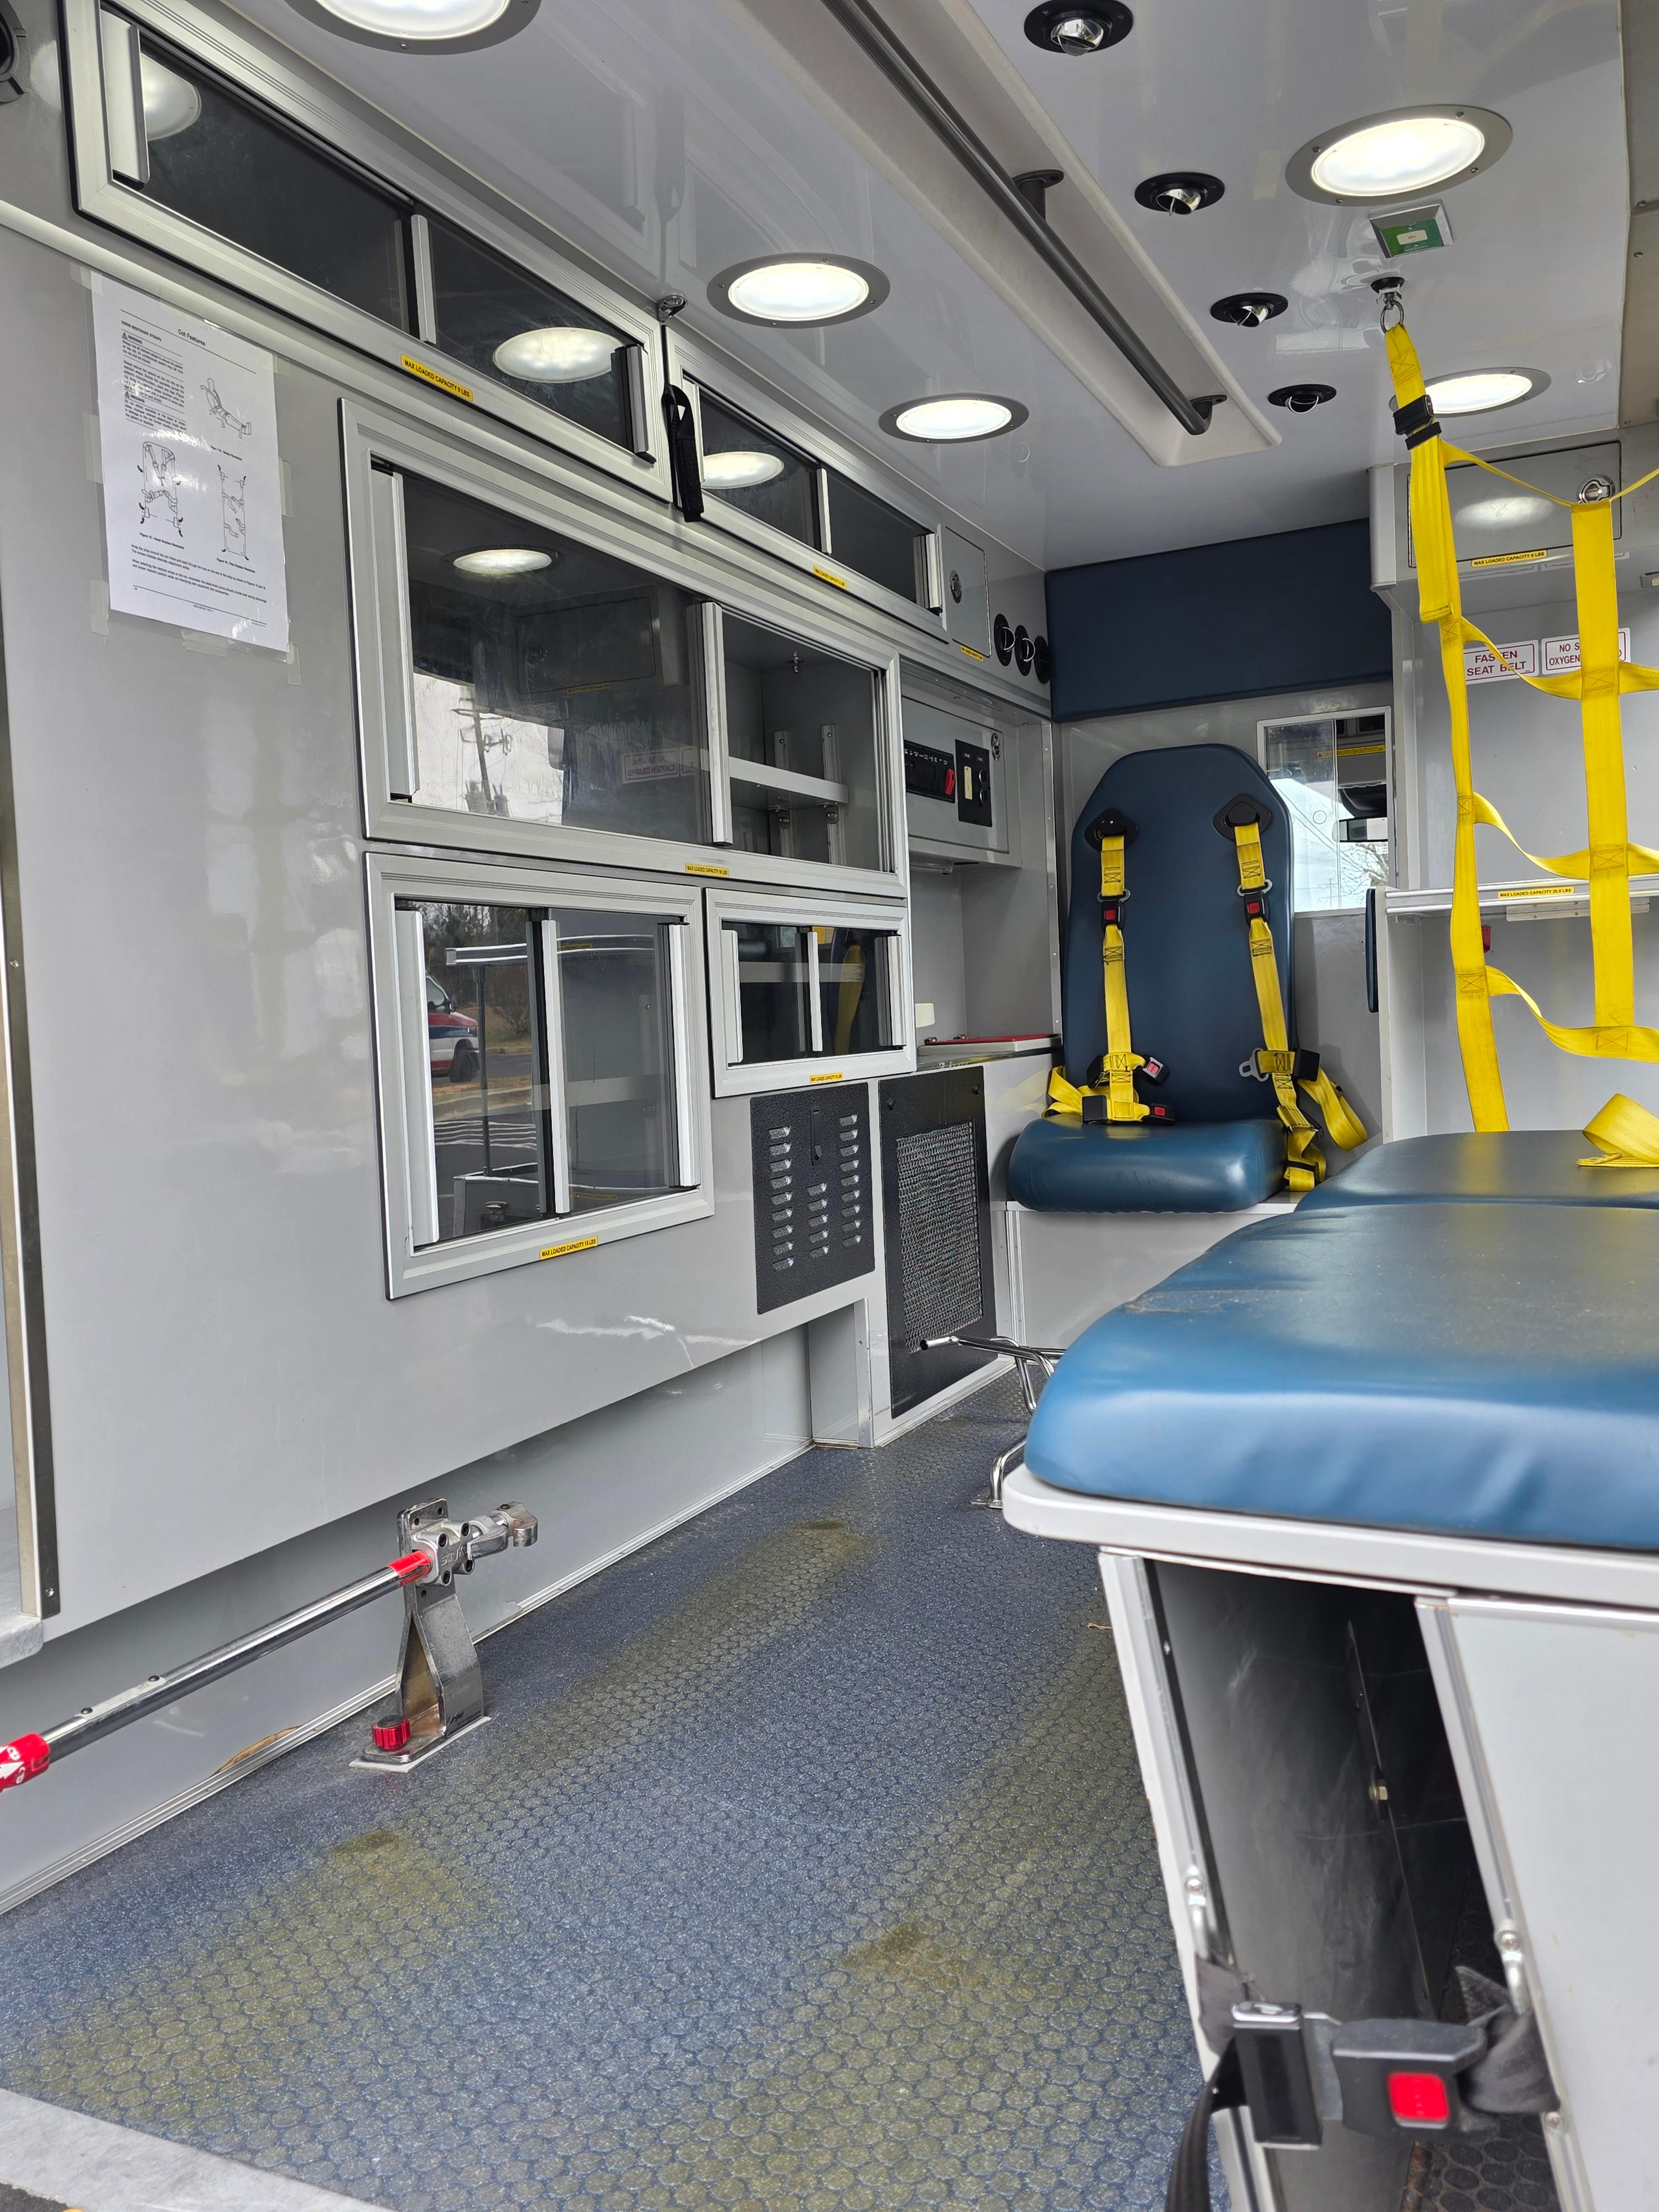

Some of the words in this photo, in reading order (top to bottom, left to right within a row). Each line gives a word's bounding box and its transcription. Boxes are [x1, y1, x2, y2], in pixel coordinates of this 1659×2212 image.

[178, 328, 186, 337] Cot
[187, 333, 206, 346] Features
[404, 359, 415, 370] MAX
[416, 365, 435, 380] LOADED
[435, 375, 457, 391] CAPACITY
[461, 389, 469, 397] LBS
[1559, 643, 1571, 653] NO
[1475, 650, 1517, 663] FASEN
[1549, 655, 1580, 666] OXYGEN
[1467, 665, 1495, 676] SEAT
[550, 1246, 566, 1255] LOADED
[566, 1242, 585, 1250] CAPACITY
